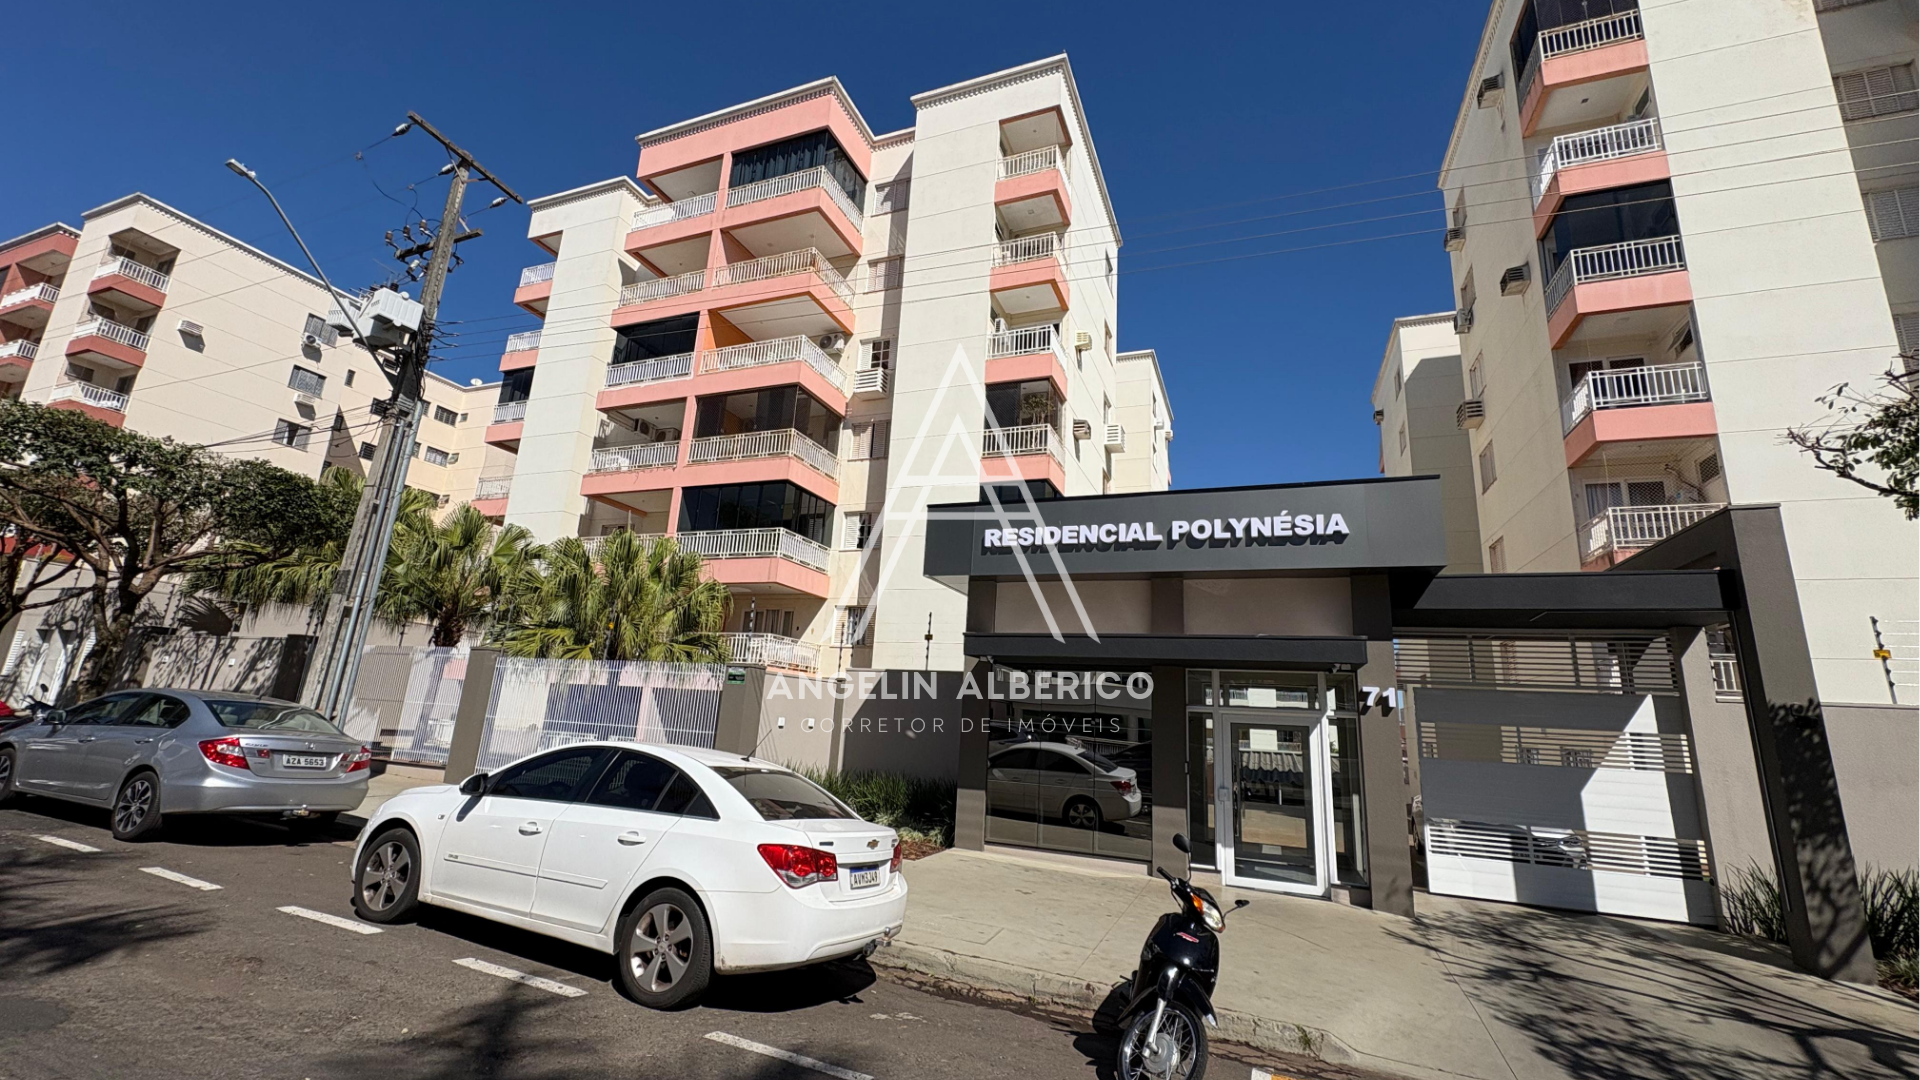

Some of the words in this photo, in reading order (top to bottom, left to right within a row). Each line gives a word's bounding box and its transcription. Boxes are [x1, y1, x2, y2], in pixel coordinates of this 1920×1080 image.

[984, 522, 1164, 547] RESIDENCIAL
[1172, 510, 1350, 540] POLYNÉSIA
[1362, 686, 1397, 708] 71
[286, 757, 302, 765] AZA
[304, 758, 324, 766] 5653
